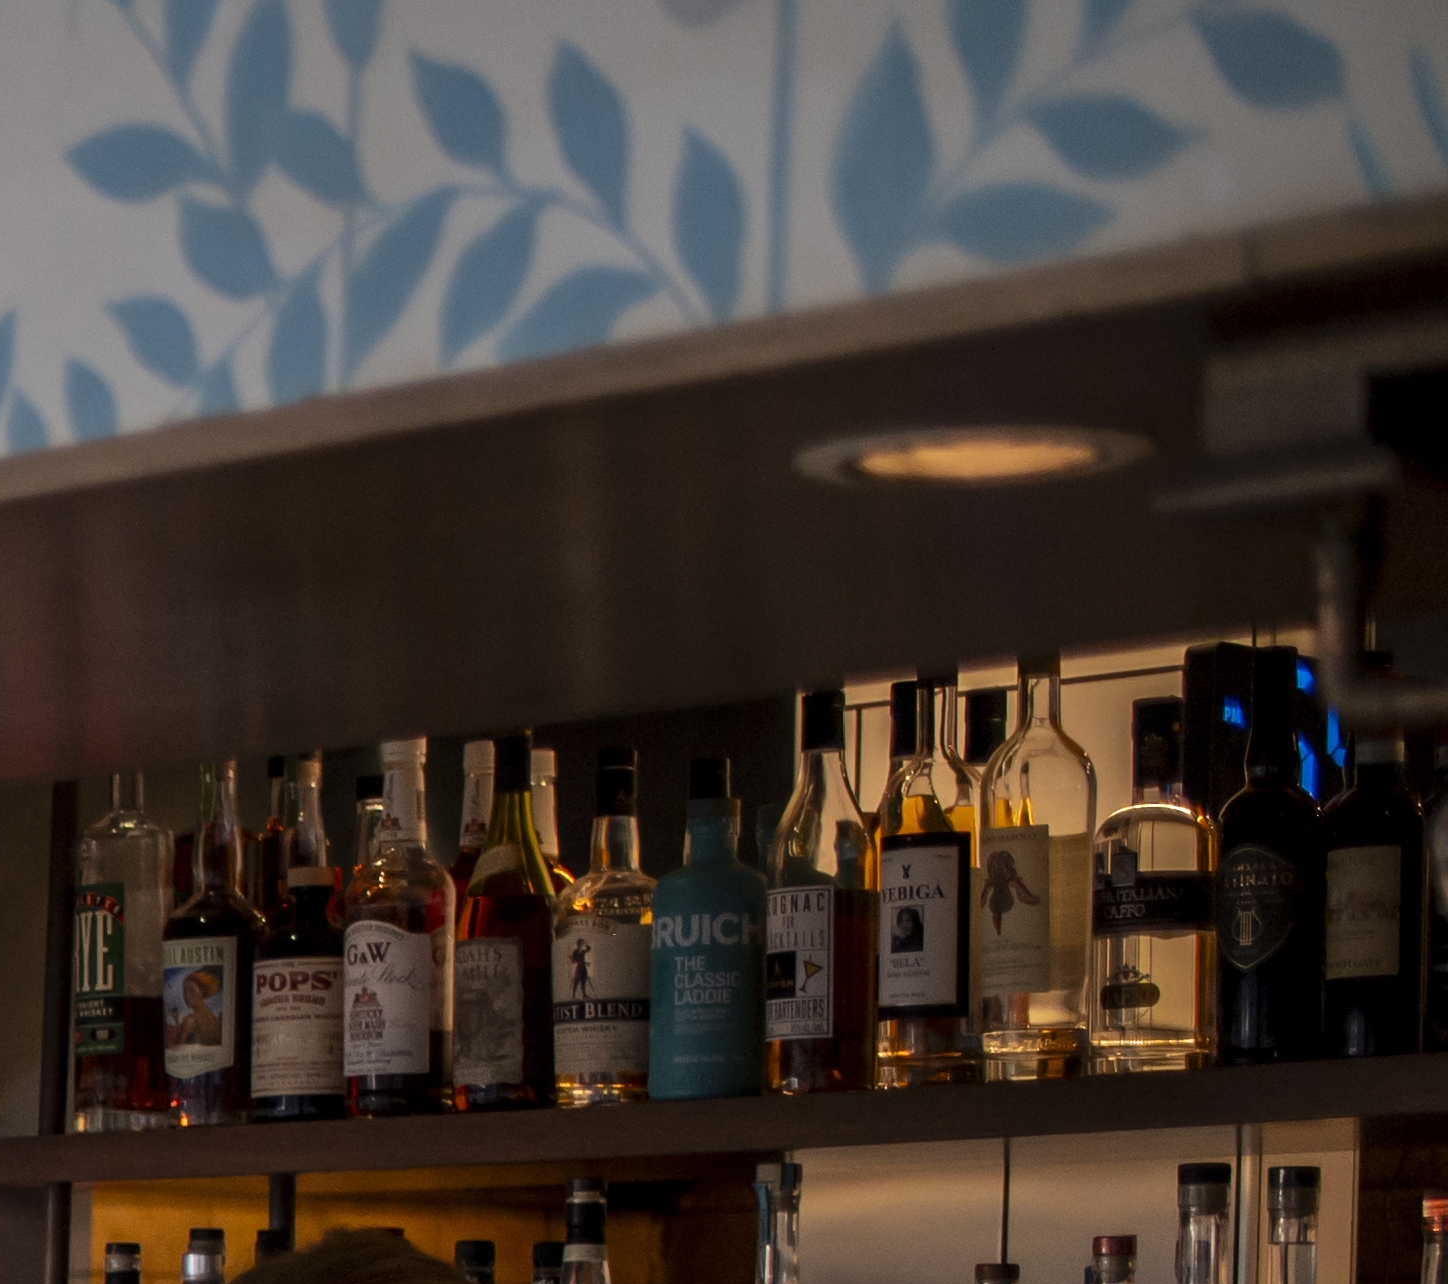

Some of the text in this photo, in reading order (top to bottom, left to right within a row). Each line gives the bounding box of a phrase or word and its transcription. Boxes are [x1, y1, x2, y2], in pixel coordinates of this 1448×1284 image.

[180, 945, 224, 963] AUSTIN
[347, 942, 391, 966] G&W
[674, 956, 706, 972] THE
[674, 972, 741, 989] CLASSIC
[674, 988, 732, 1005] LADDIE
[584, 1002, 643, 1019] BLEND
